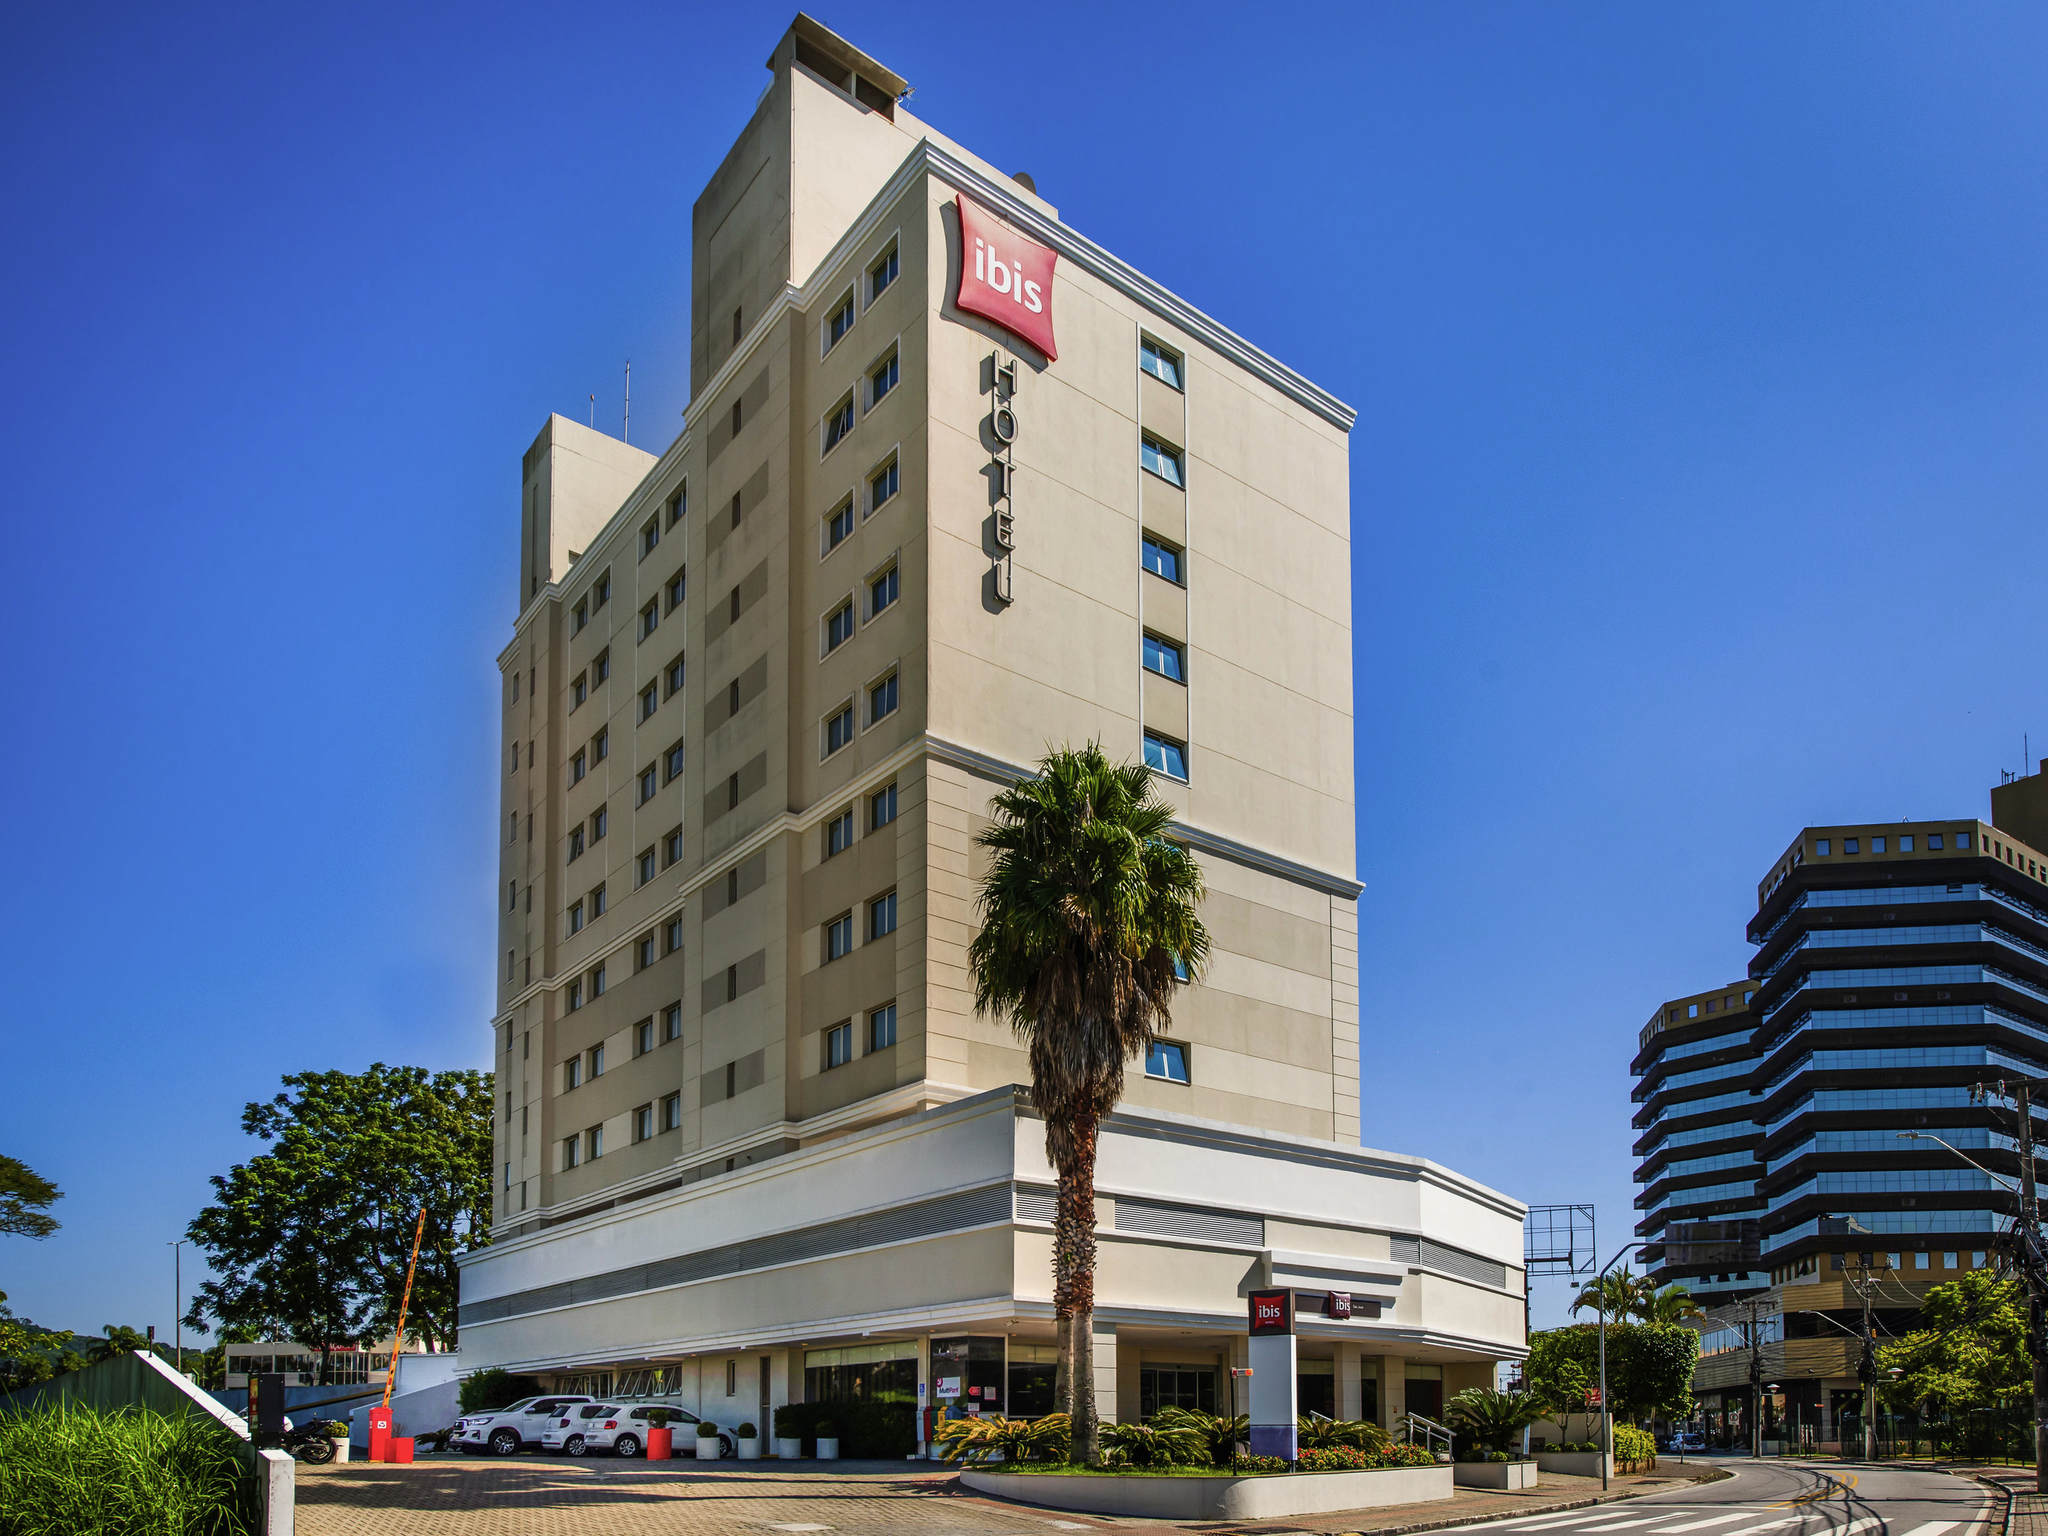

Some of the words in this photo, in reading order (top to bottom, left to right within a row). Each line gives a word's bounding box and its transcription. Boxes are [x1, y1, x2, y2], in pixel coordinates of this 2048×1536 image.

[975, 237, 1043, 313] ibis
[992, 349, 1018, 604] HOTEL
[1258, 1304, 1280, 1318] ibis
[1335, 1299, 1350, 1311] ibis
